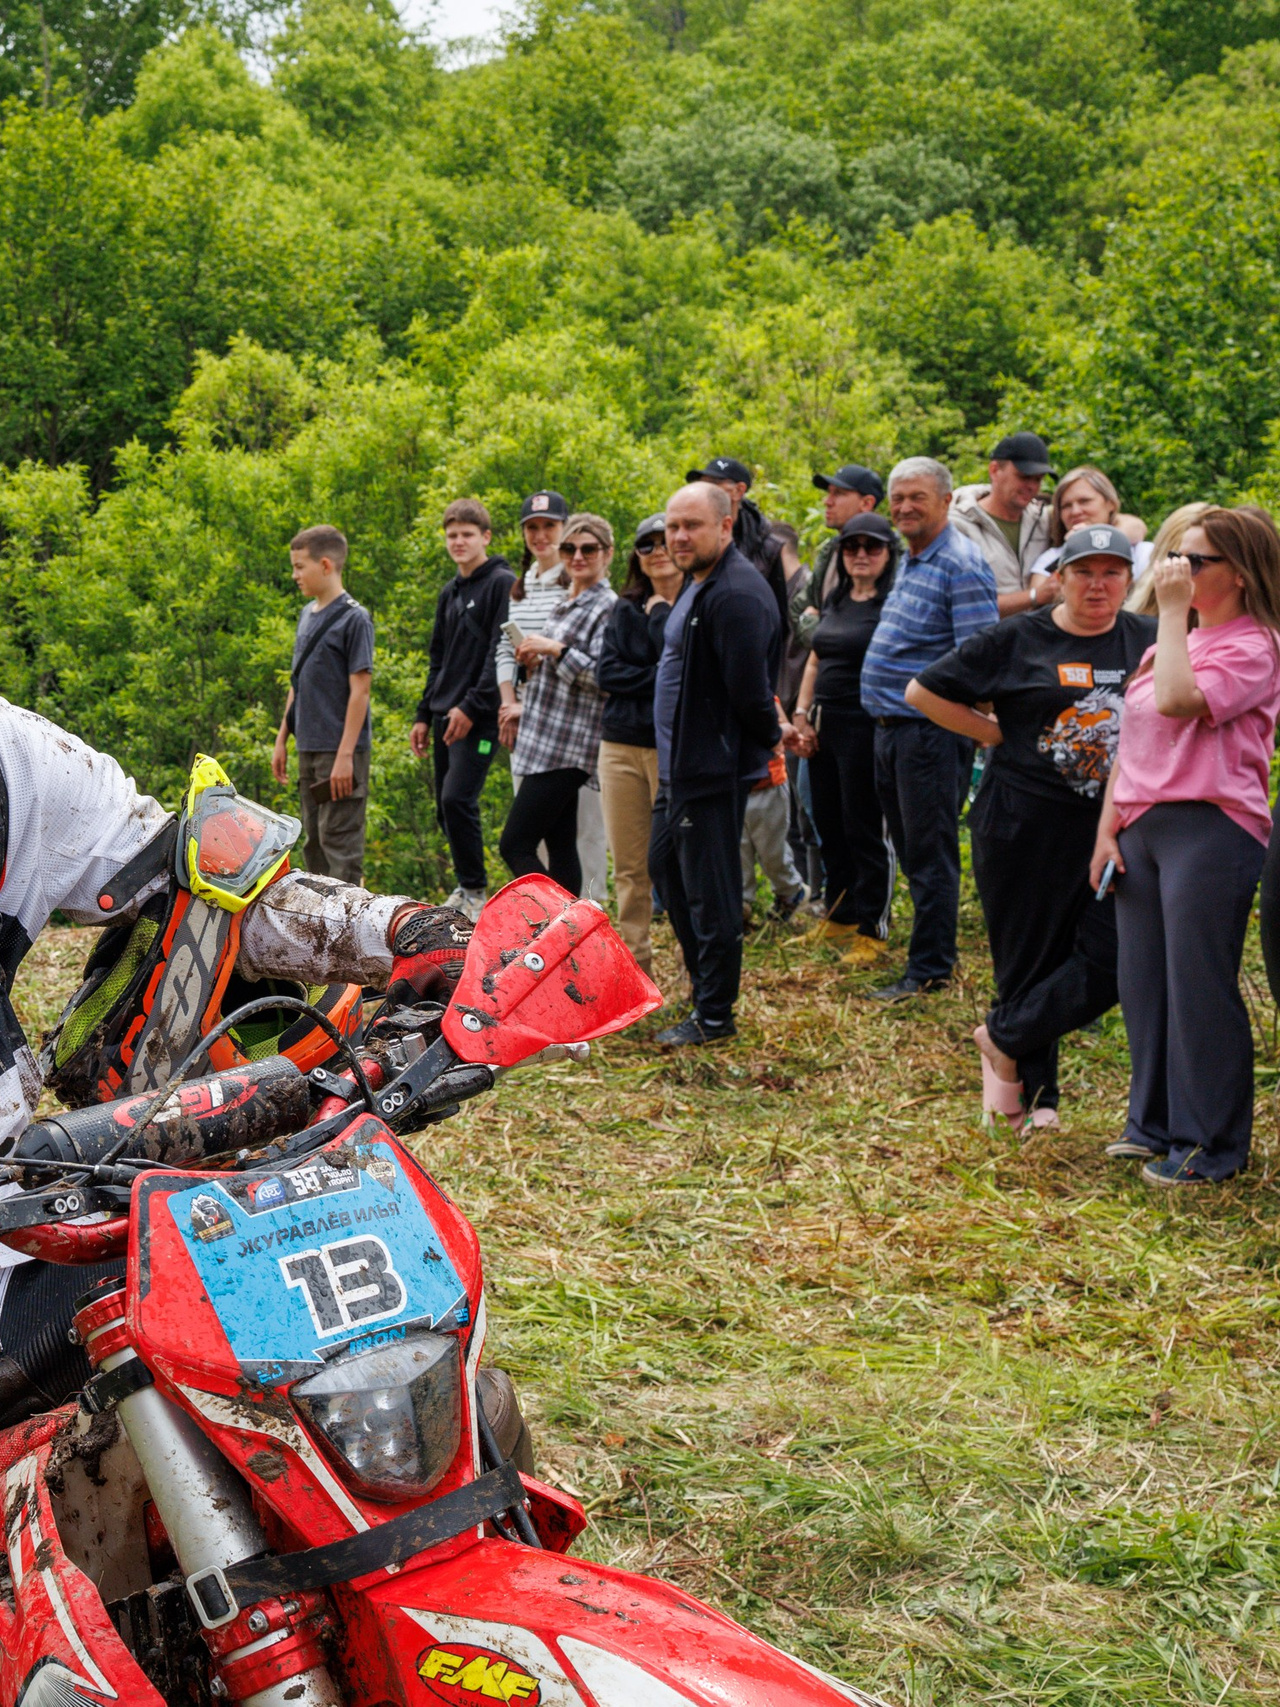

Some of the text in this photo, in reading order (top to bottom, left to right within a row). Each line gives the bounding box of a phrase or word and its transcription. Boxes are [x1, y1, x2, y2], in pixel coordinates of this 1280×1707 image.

[237, 1211, 352, 1257] ЖУРАВЛЁВ
[354, 1201, 401, 1223] ИЛЬЯ
[279, 1235, 407, 1338] 13
[349, 1326, 407, 1355] IRON
[418, 1648, 541, 1702] FMF
